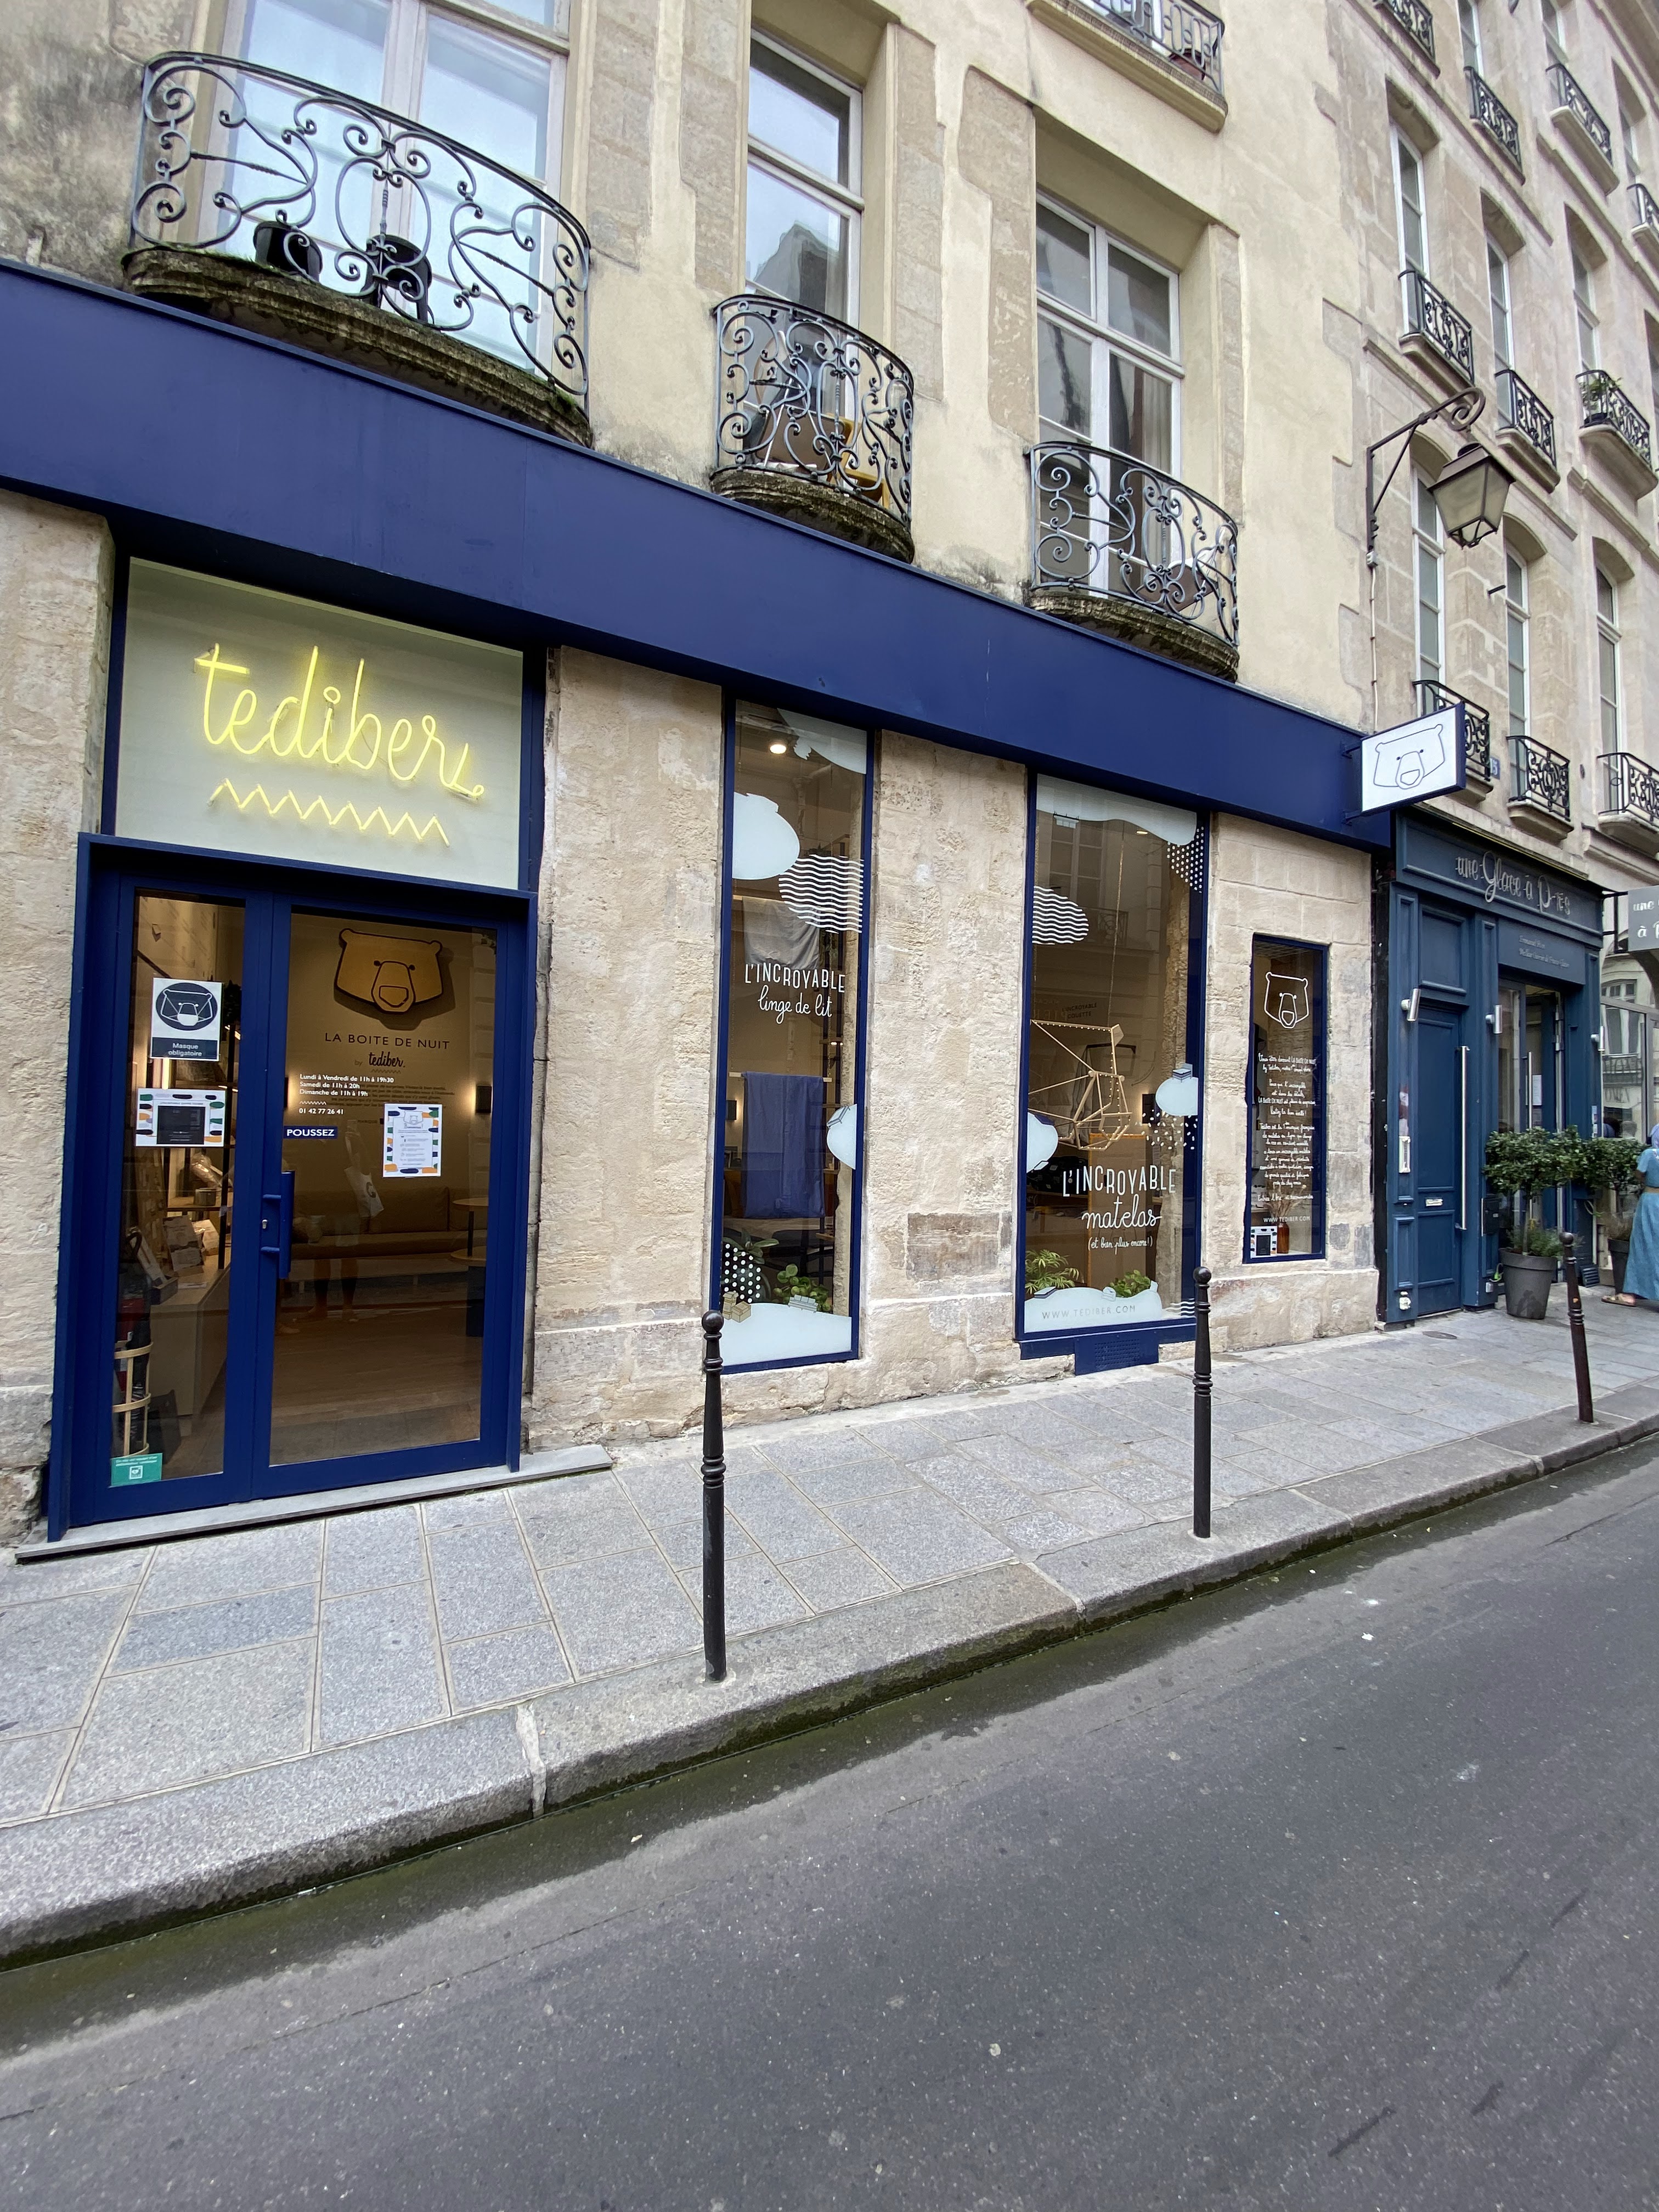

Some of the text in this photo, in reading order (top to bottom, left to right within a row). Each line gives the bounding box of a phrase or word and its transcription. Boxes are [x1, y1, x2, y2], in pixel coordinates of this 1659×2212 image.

[194, 642, 484, 797] tediber
[1633, 901, 1655, 911] une
[1638, 926, 1647, 938] à
[745, 962, 845, 993] L'INCROYABLE
[757, 985, 832, 1024] linge de lit
[325, 1032, 450, 1049] LA BOITE DE NUIT
[1063, 1165, 1176, 1197] L'INCROYABLE
[1081, 1194, 1163, 1229] matelas
[1088, 1237, 1099, 1251] (et
[1101, 1237, 1113, 1248] bien
[1114, 1236, 1130, 1255] plus
